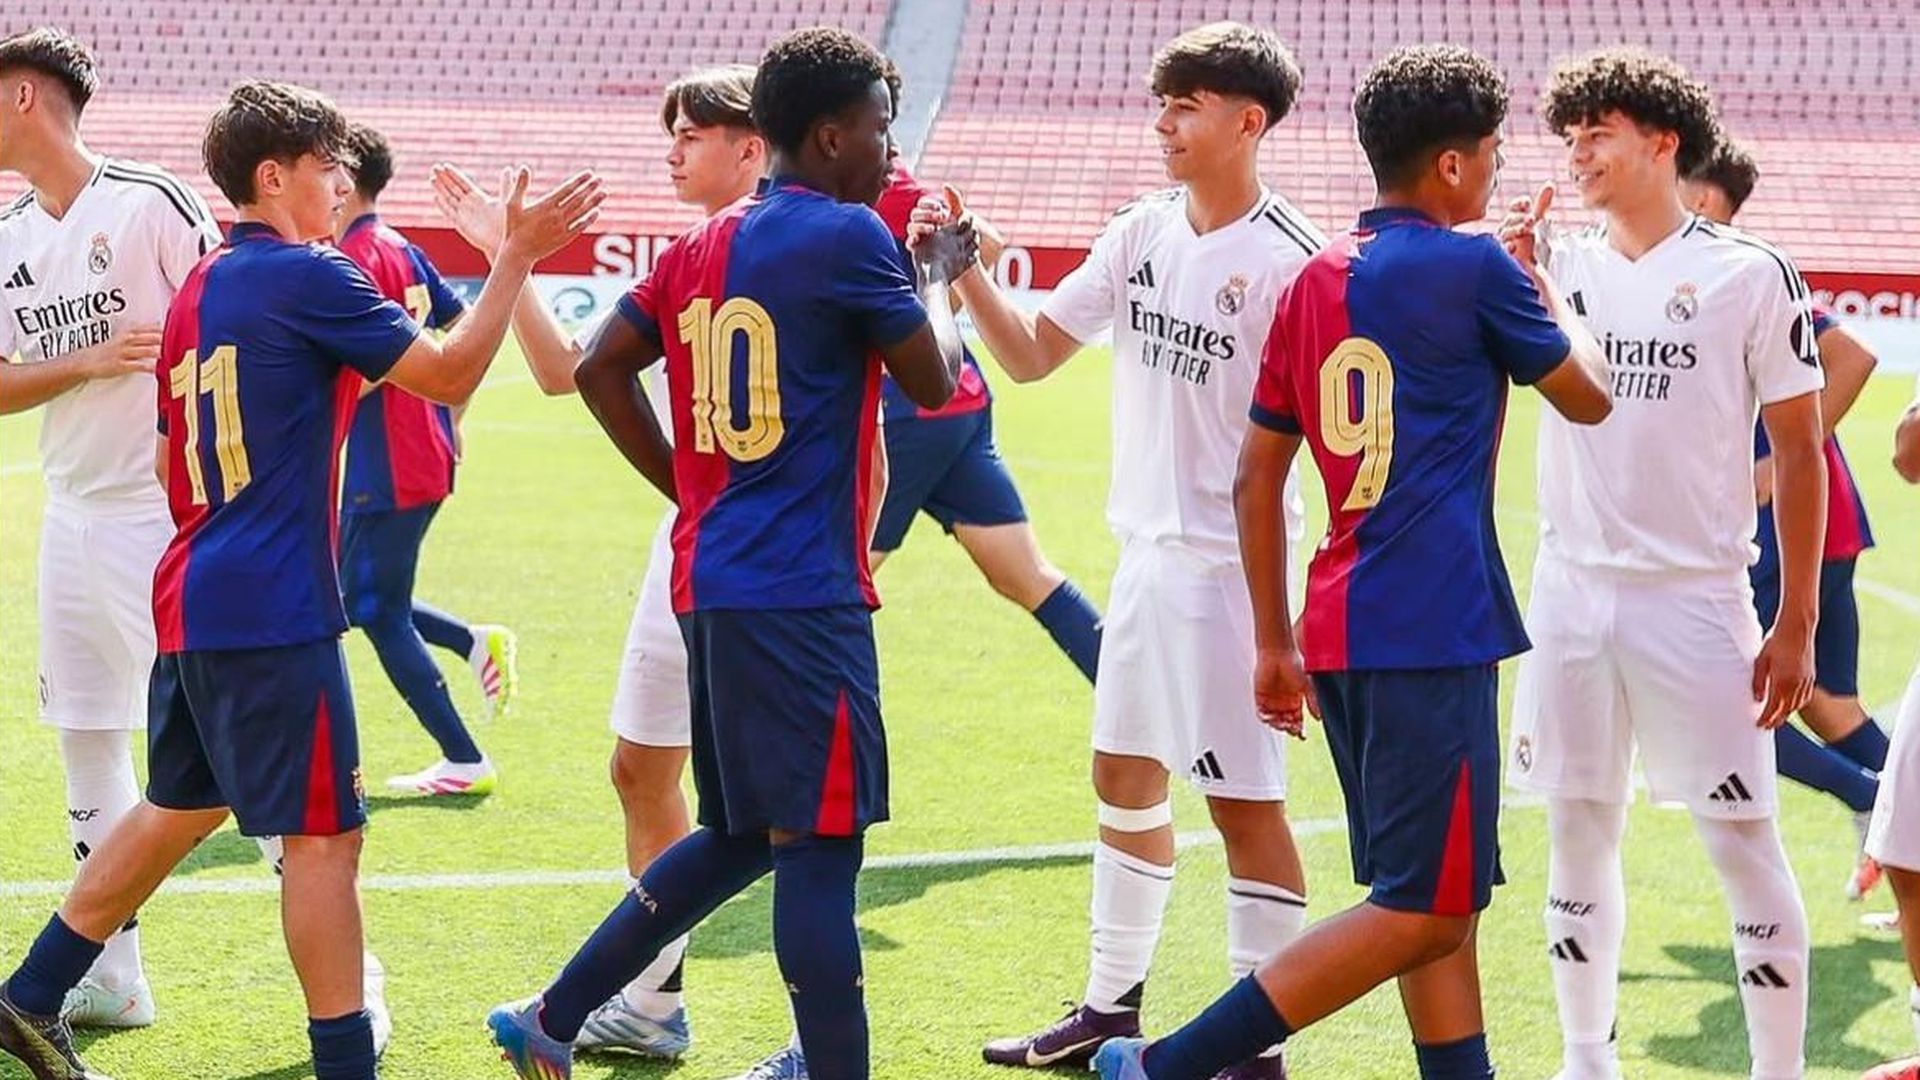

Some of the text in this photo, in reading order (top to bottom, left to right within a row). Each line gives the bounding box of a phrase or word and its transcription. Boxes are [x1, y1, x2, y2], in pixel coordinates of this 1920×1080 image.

[15, 288, 126, 335] Emirates
[1130, 300, 1236, 360] Emrates
[1595, 332, 1697, 370] irates
[169, 345, 252, 505] 11
[678, 296, 785, 463] 10
[1319, 337, 1395, 512] 9
